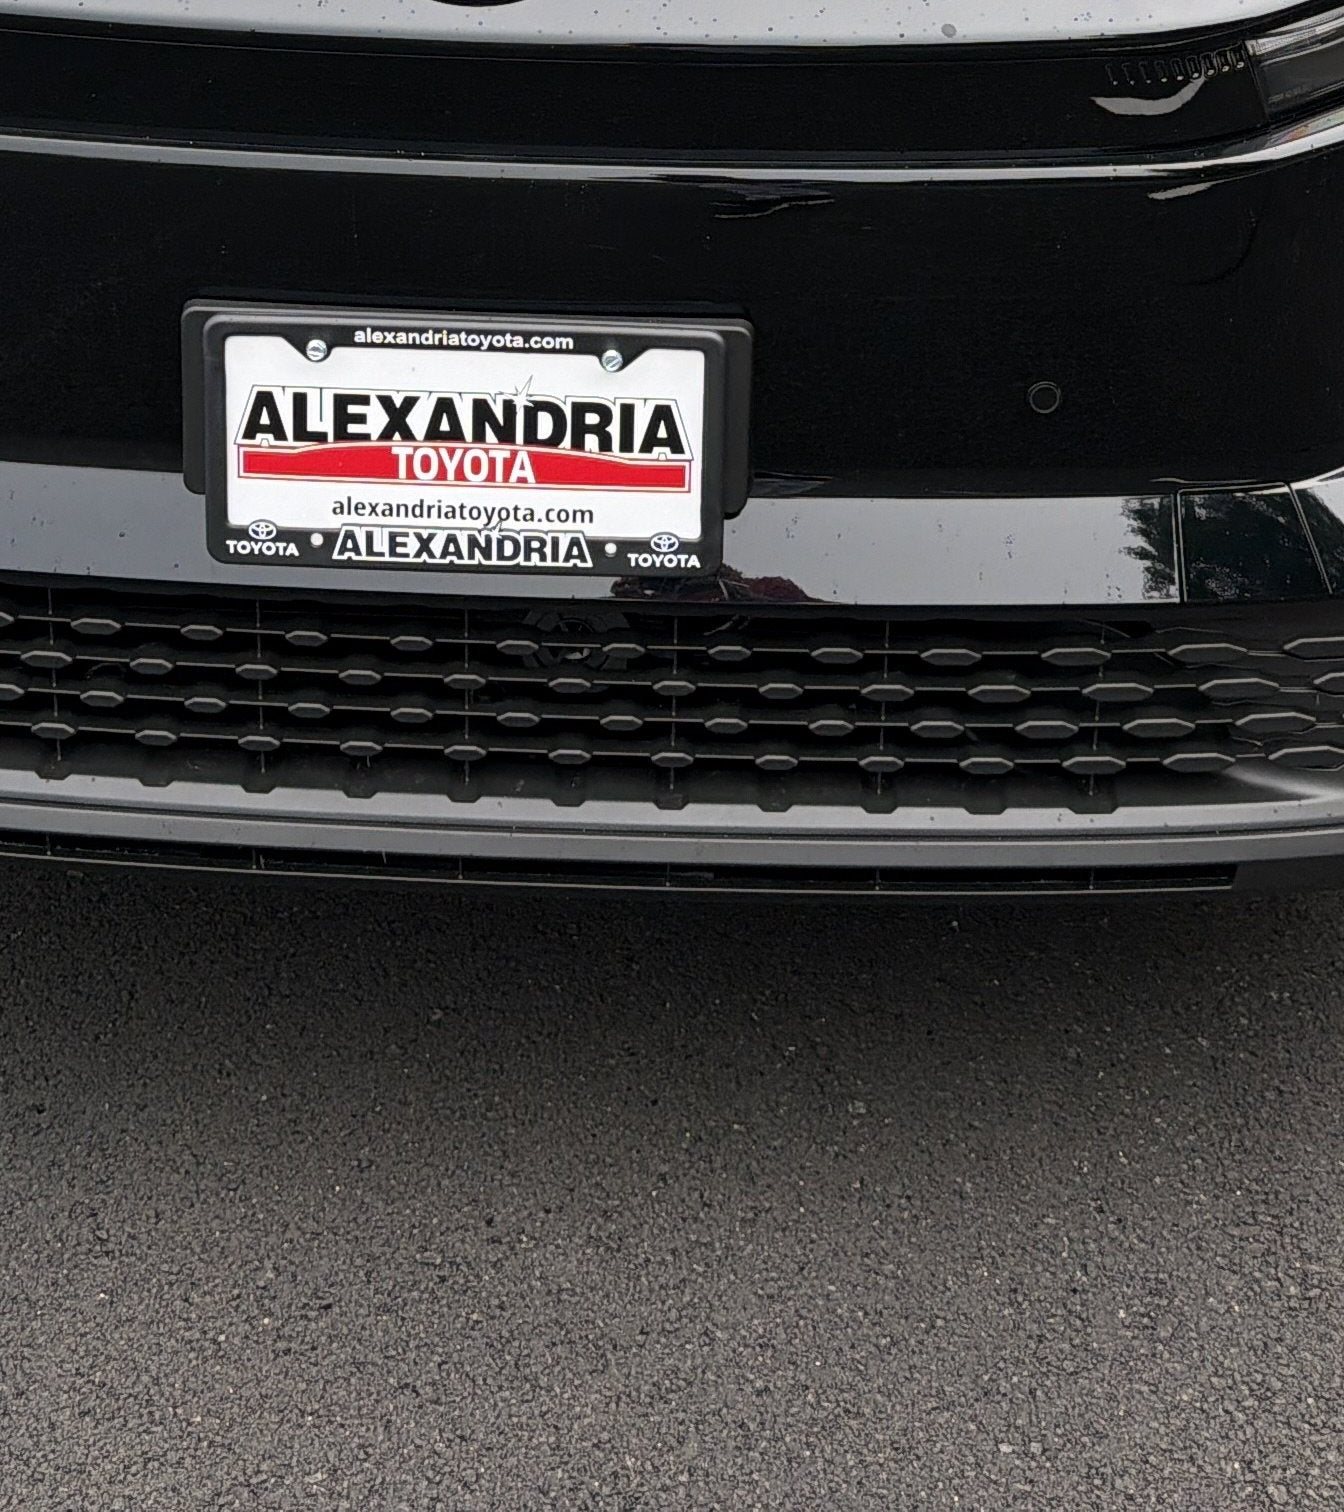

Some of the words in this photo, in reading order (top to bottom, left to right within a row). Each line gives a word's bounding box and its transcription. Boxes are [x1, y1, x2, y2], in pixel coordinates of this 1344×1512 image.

[353, 326, 575, 351] alexandriatoyota.com
[239, 387, 689, 457] ALEXANDRIA
[391, 444, 537, 485] TOYOTA
[331, 495, 595, 527] alexandriatoyota.com
[225, 539, 300, 557] TOYOTA
[333, 526, 593, 566] ALEXANDRIA
[626, 553, 702, 569] TOYOTA
